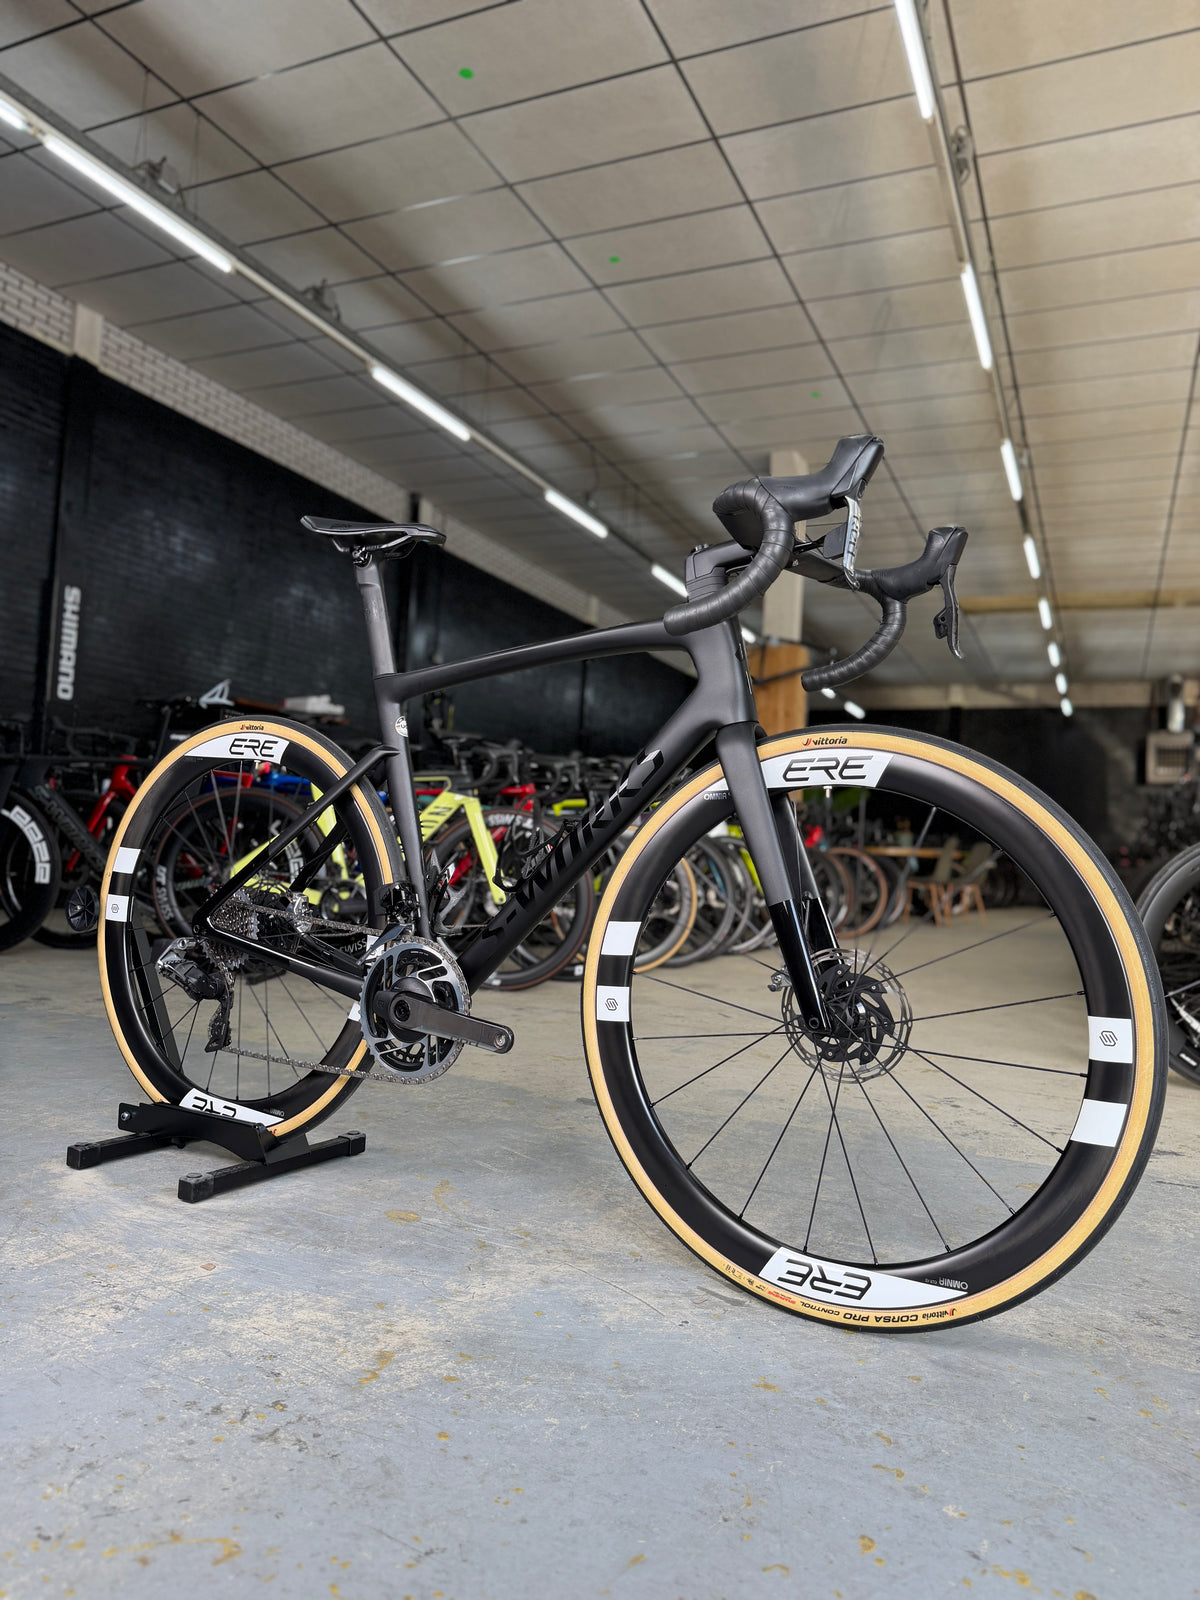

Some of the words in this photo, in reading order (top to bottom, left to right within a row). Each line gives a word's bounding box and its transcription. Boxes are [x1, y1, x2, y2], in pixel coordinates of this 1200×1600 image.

[57, 584, 81, 700] SHIMANO
[229, 738, 279, 758] ERE
[812, 736, 848, 746] vittoria
[782, 755, 874, 782] ERE
[777, 1258, 872, 1300] ERE
[938, 1277, 969, 1290] OMNIA
[800, 1300, 840, 1316] CONTROL
[922, 1310, 950, 1320] vittoria
[843, 1312, 870, 1323] PRO
[874, 1314, 919, 1323] CORSA
